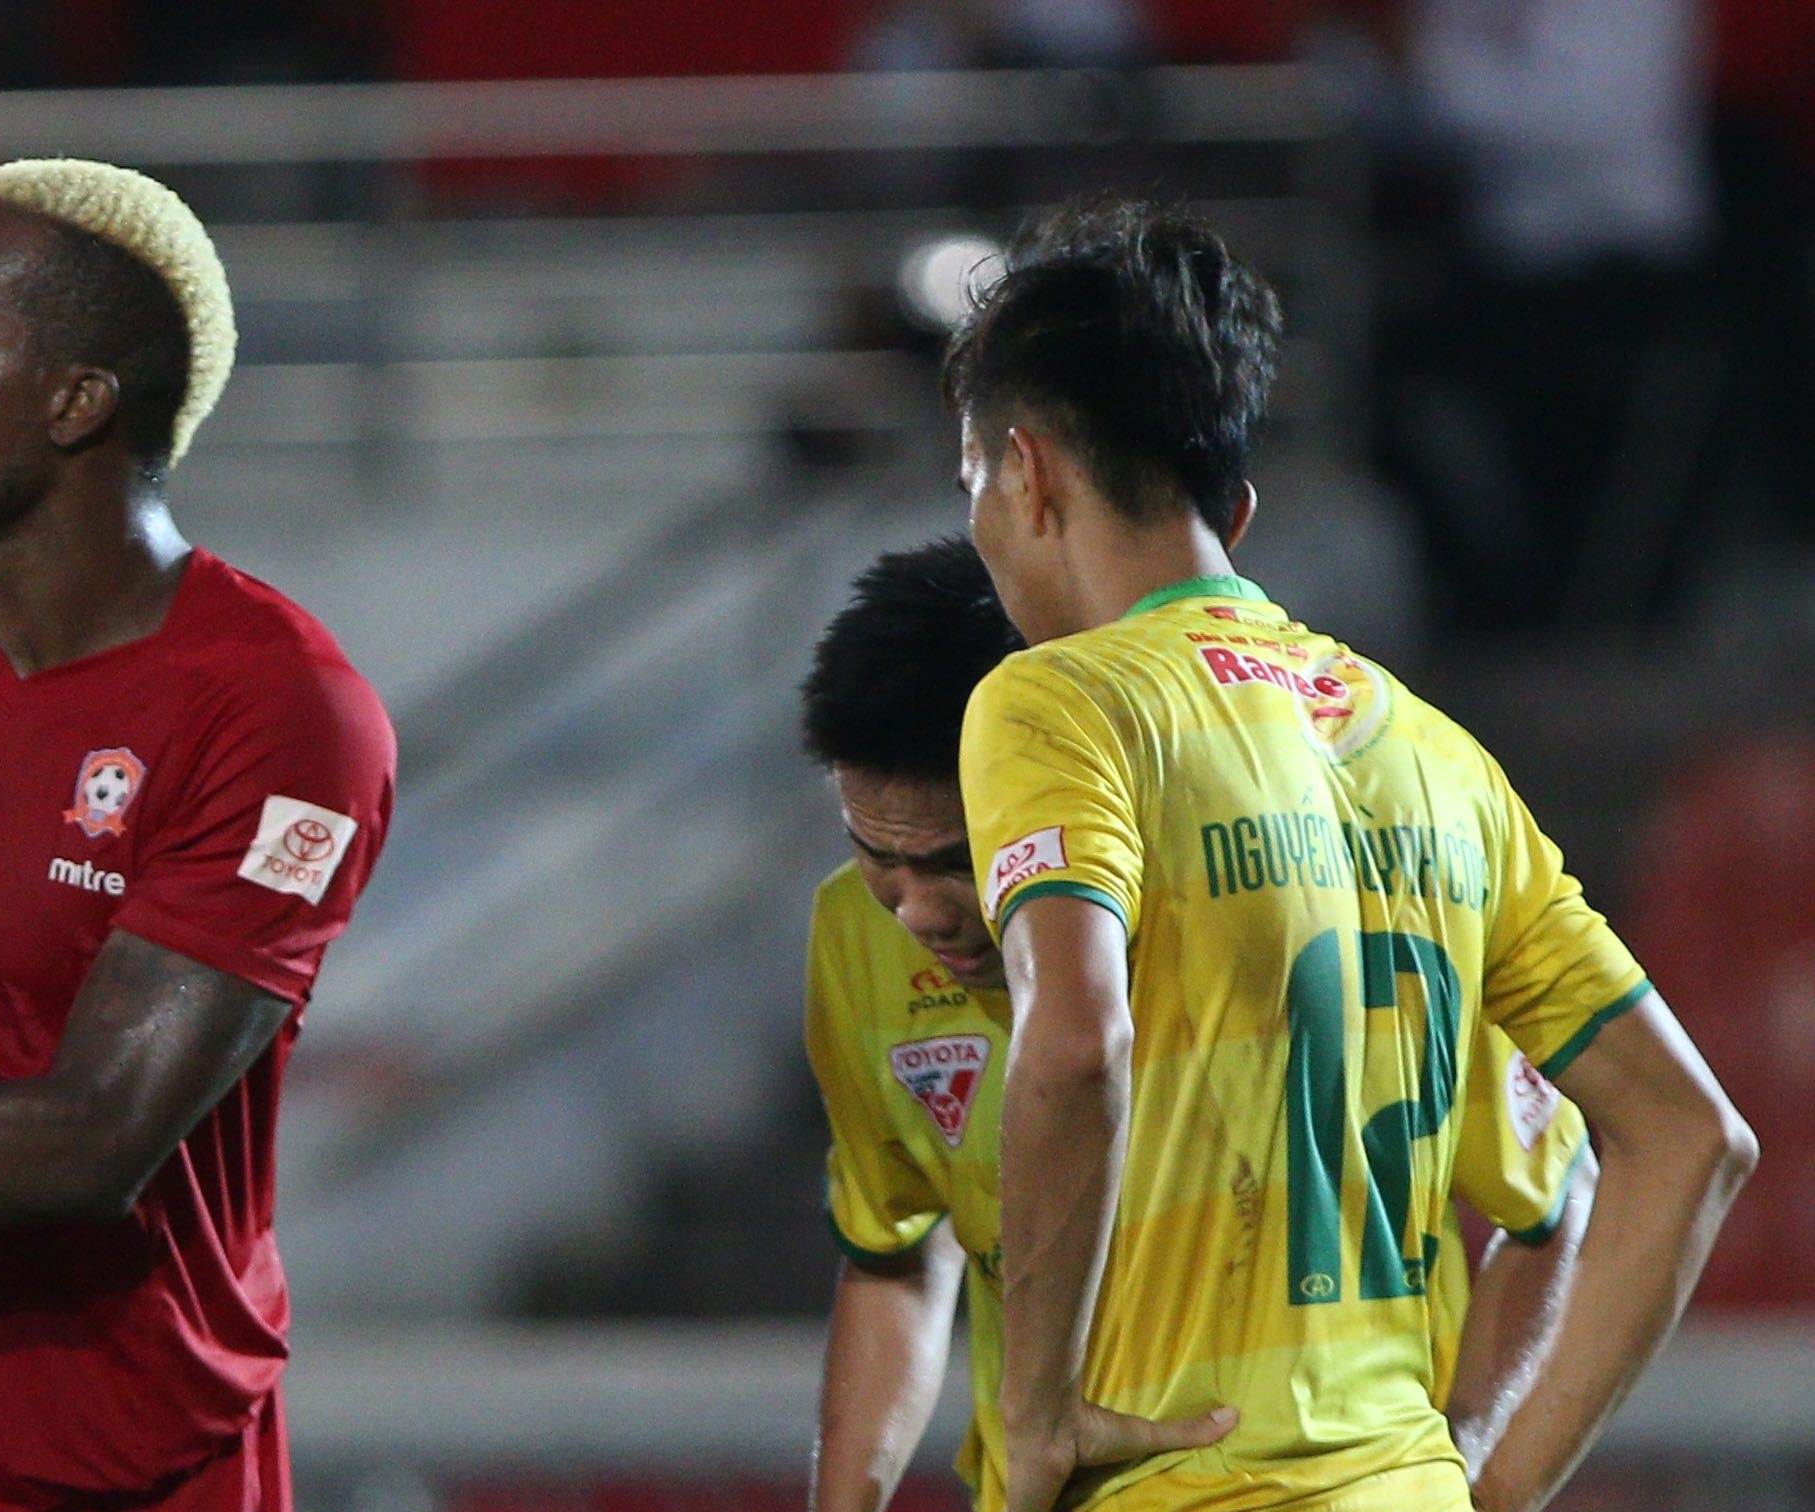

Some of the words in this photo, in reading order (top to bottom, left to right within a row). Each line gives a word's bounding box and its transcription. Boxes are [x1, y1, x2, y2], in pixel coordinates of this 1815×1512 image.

[1199, 646, 1348, 700] Ranee
[48, 857, 126, 896] mitre
[1286, 929, 1462, 1306] 12
